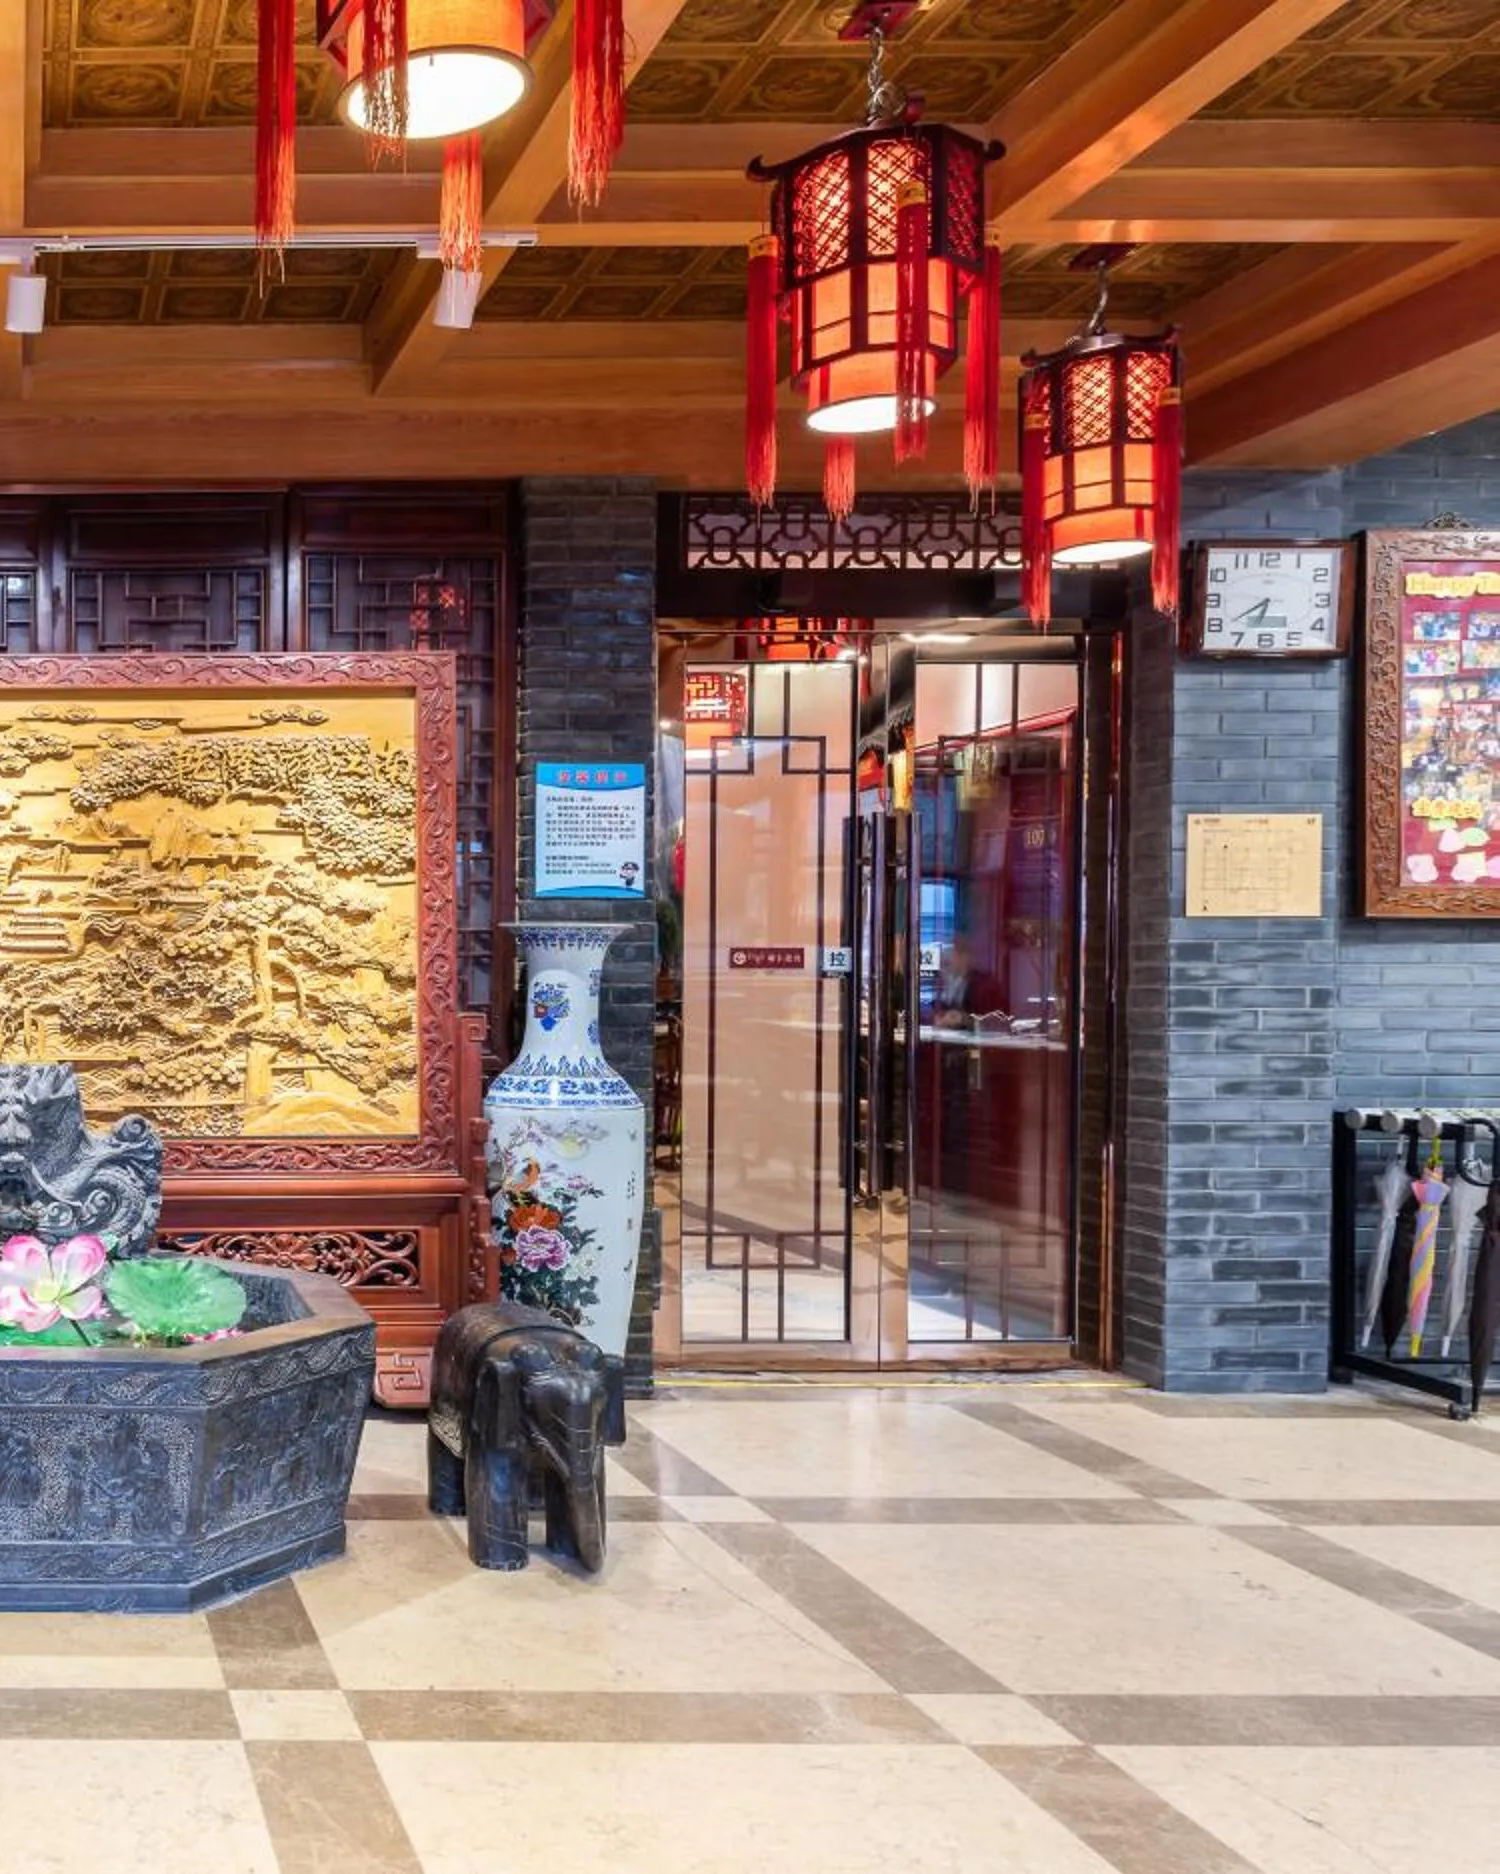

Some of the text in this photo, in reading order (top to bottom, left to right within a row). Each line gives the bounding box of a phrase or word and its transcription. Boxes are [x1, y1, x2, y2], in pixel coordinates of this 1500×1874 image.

[1234, 552, 1249, 569] 11
[1259, 552, 1281, 568] 12
[1295, 552, 1301, 569] 1
[1210, 567, 1227, 582] 10
[1312, 567, 1329, 582] 2
[1206, 593, 1221, 608] 9
[1315, 593, 1331, 608] 3
[1207, 617, 1223, 633] 8
[1310, 617, 1325, 631] 4
[1230, 631, 1245, 646] 7
[1257, 633, 1275, 648] 6
[1285, 631, 1302, 646] 5
